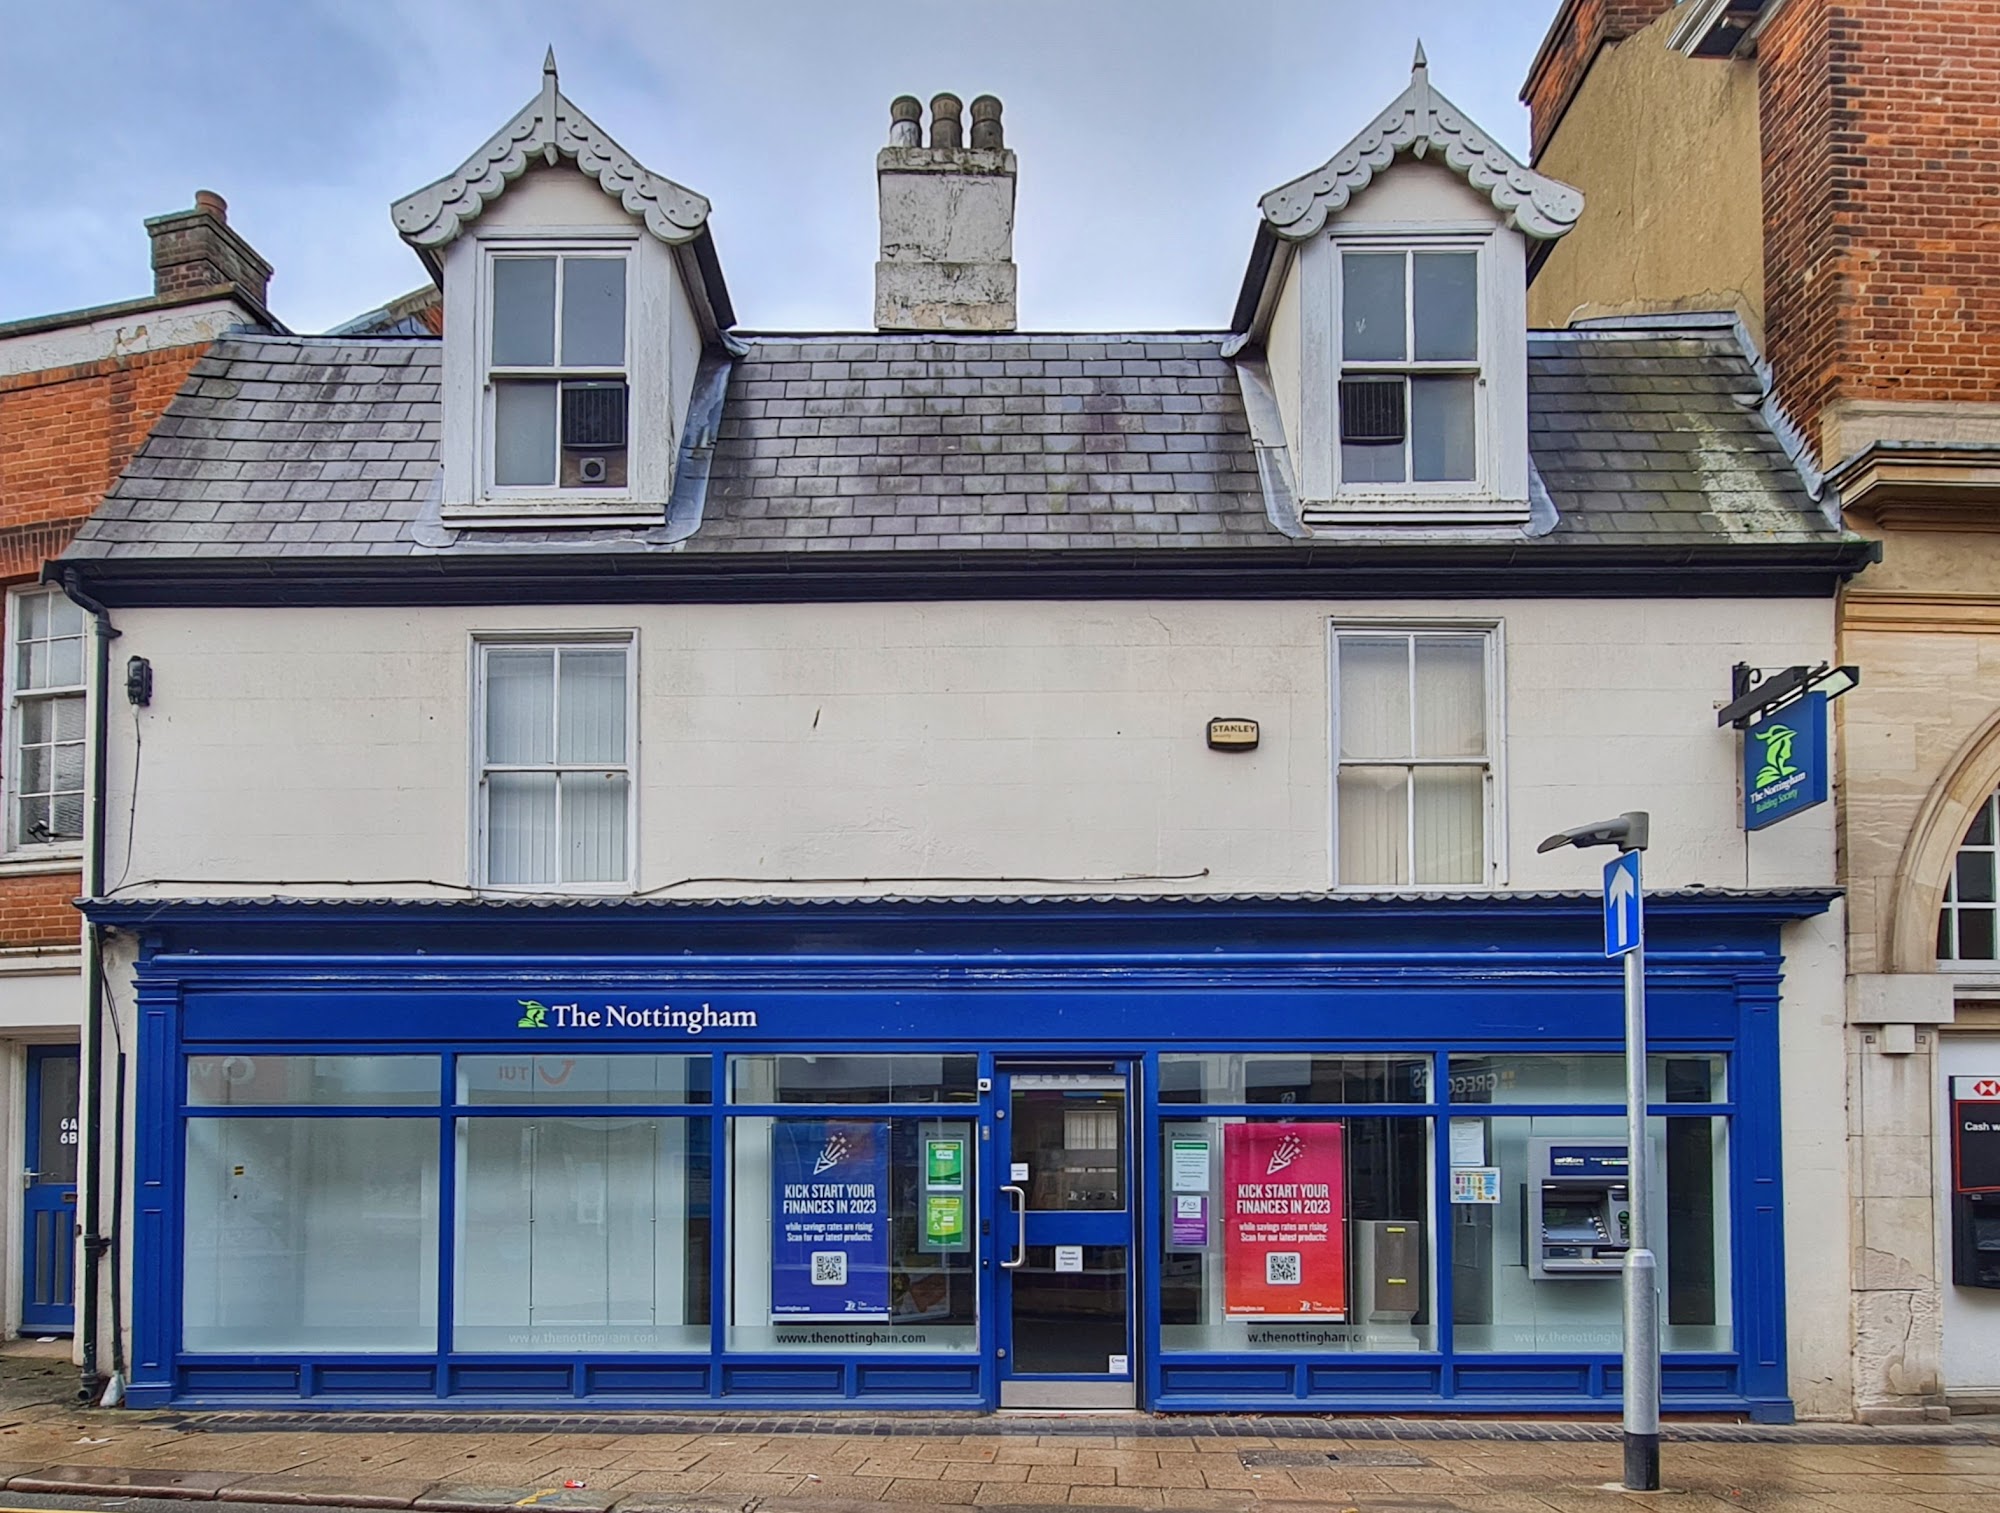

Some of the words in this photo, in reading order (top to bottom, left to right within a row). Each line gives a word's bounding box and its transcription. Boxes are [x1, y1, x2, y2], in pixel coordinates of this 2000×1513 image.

[1212, 725, 1256, 733] STANLEY
[1750, 791, 1767, 804] The
[1763, 771, 1806, 797] Nottingham
[552, 1003, 601, 1027] The
[605, 1003, 757, 1034] Nottingham
[60, 1118, 78, 1130] 6A
[1964, 1121, 1990, 1131] Cash
[60, 1132, 78, 1144] 6B
[784, 1184, 809, 1198] KICK
[811, 1184, 844, 1198] START
[846, 1184, 875, 1198] YOUR
[1238, 1184, 1263, 1198] KICK
[1265, 1184, 1298, 1198] START
[1300, 1184, 1329, 1198] YOUR
[783, 1200, 834, 1214] FINANCES
[836, 1200, 848, 1214] IN
[850, 1200, 877, 1214] 2023
[1236, 1200, 1288, 1214] FINANCES
[1290, 1200, 1301, 1214] IN
[1304, 1200, 1331, 1214] 2023
[785, 1222, 801, 1231] while
[803, 1222, 825, 1233] savings
[827, 1223, 843, 1231] rates
[1256, 1222, 1280, 1233] savings
[787, 1232, 802, 1241] Scan
[803, 1233, 812, 1241] for
[825, 1233, 843, 1241] latest
[1241, 1232, 1256, 1242] Scan
[1257, 1233, 1266, 1241] for
[1279, 1233, 1297, 1241] latest
[776, 1332, 926, 1346] www.thenottingham.com
